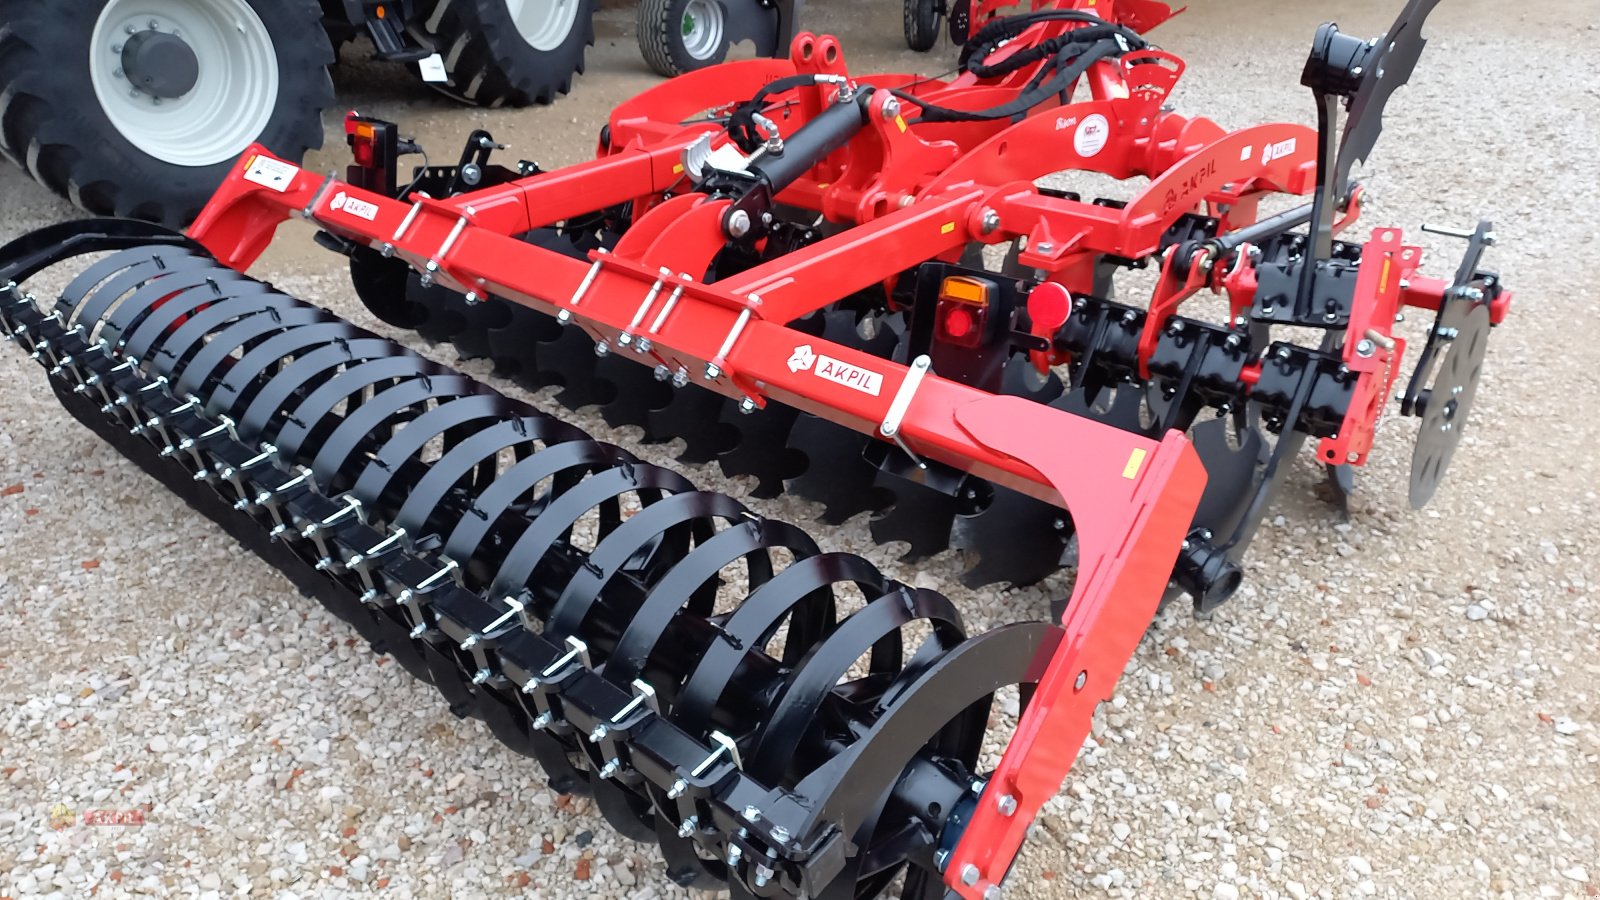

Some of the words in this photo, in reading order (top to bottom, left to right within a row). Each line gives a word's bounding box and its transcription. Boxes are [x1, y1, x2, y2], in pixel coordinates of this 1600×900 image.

[1181, 159, 1216, 200] AKPIL
[348, 201, 371, 217] AKPIL
[821, 361, 871, 389] AKPIL
